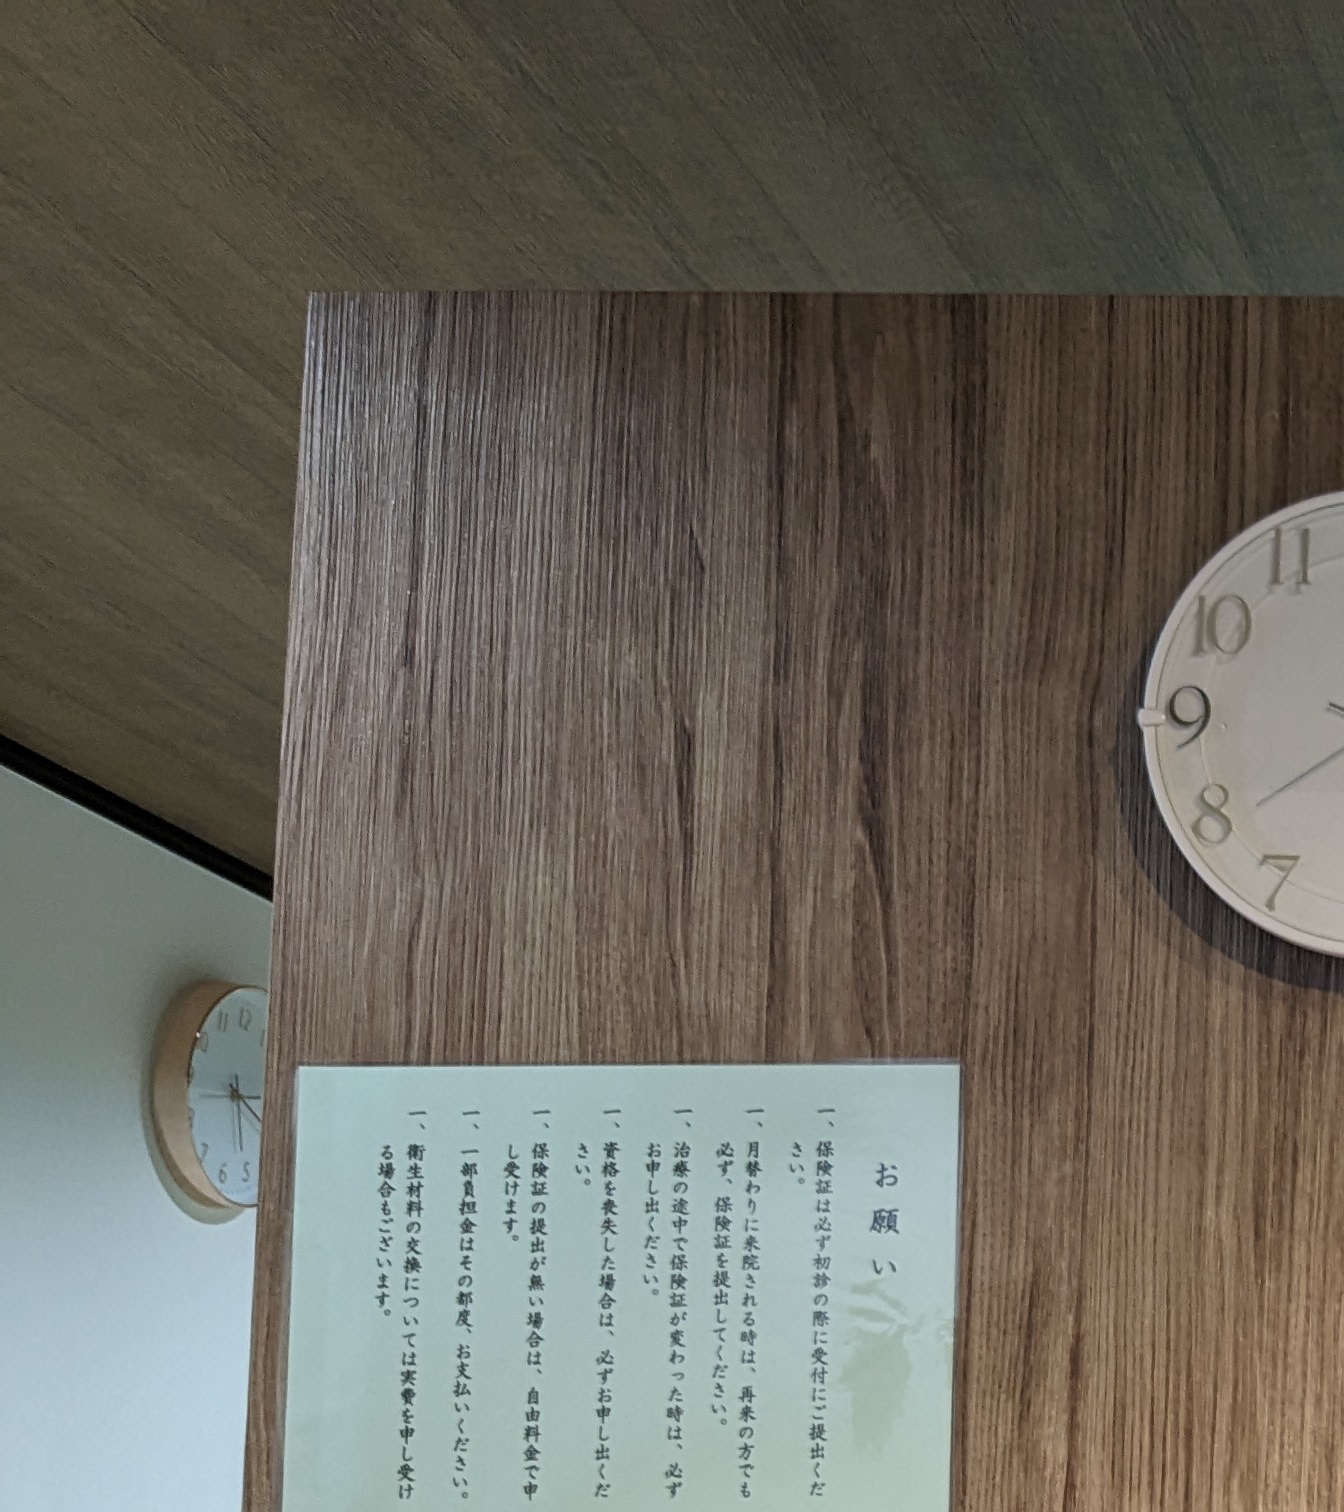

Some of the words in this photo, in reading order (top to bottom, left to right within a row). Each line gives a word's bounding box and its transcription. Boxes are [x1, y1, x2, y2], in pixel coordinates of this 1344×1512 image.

[1269, 527, 1313, 586] 11
[1190, 594, 1252, 656] 10
[1169, 685, 1211, 750] 9
[1191, 783, 1232, 845] 8
[1261, 854, 1299, 911] 7
[503, 1143, 520, 1242] し受けます。
[576, 1143, 592, 1186] さい。
[790, 1141, 806, 1185] さい。
[376, 1143, 396, 1316] る場合もございます。
[644, 1143, 661, 1296] お申し出ください。
[870, 1162, 899, 1277] お願い
